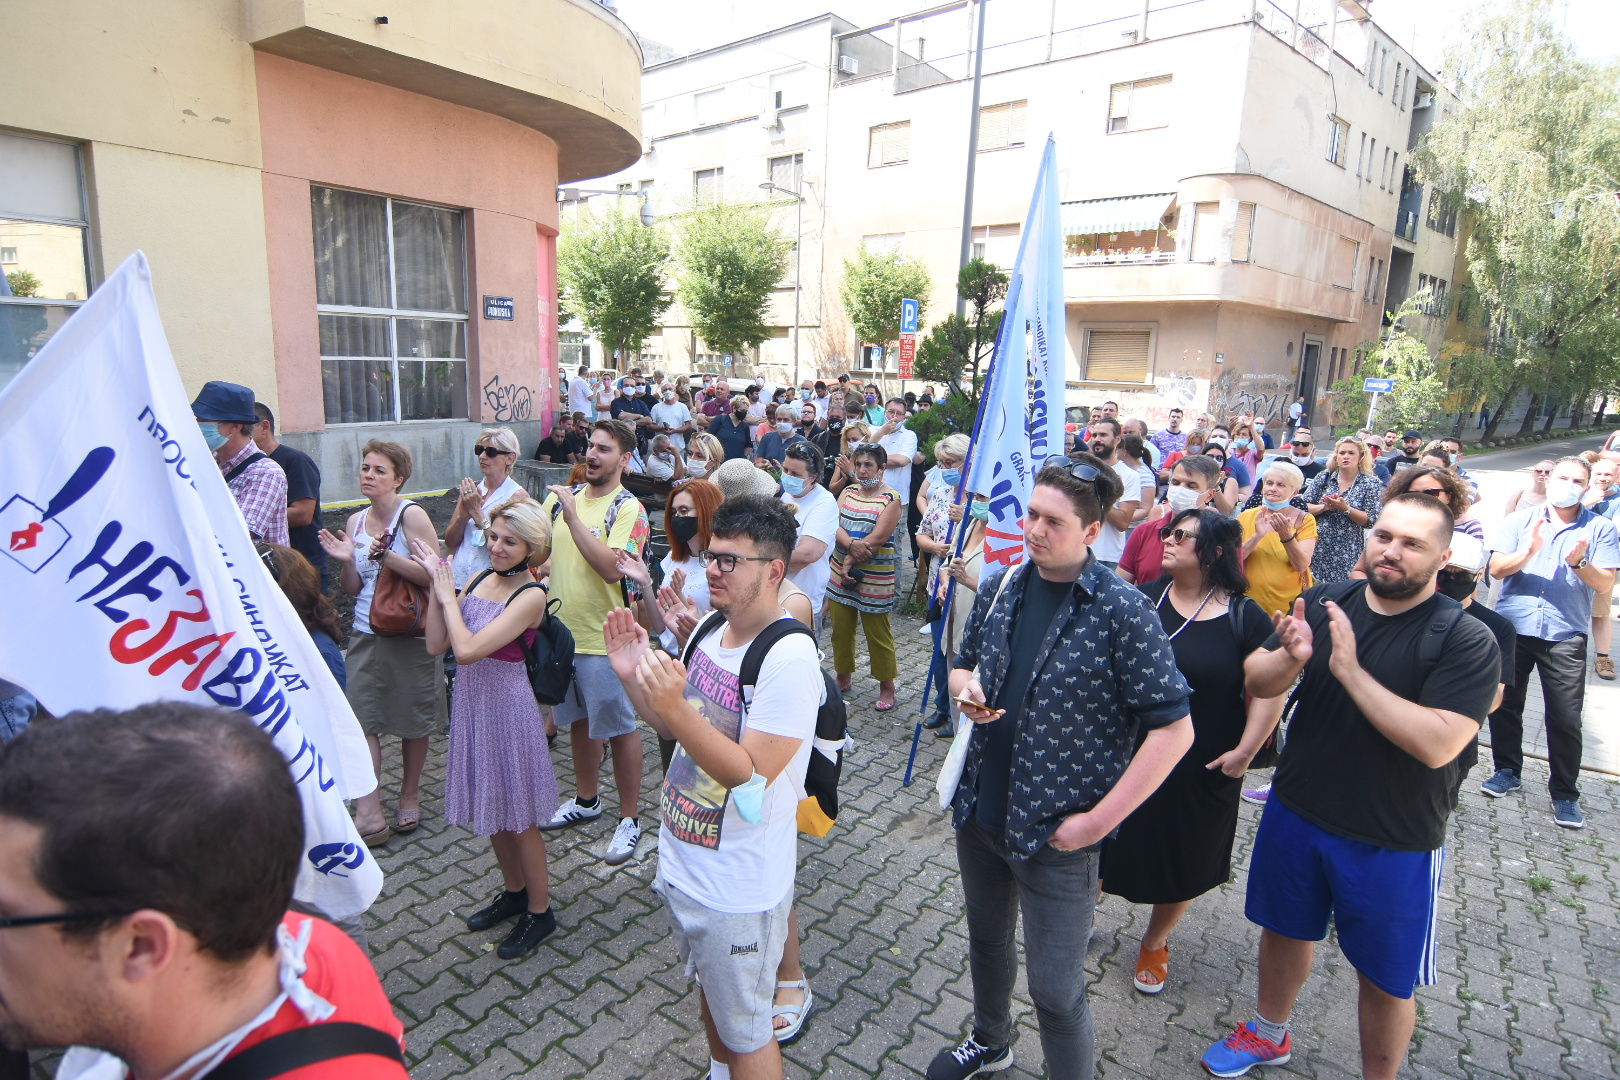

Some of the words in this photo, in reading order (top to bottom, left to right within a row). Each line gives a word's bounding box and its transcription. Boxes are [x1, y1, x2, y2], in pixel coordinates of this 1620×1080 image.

[905, 303, 914, 328] P
[1145, 406, 1199, 420] MADRO
[697, 652, 722, 678] VELVET
[694, 668, 741, 712] THEATRE
[673, 824, 719, 848] SHOW
